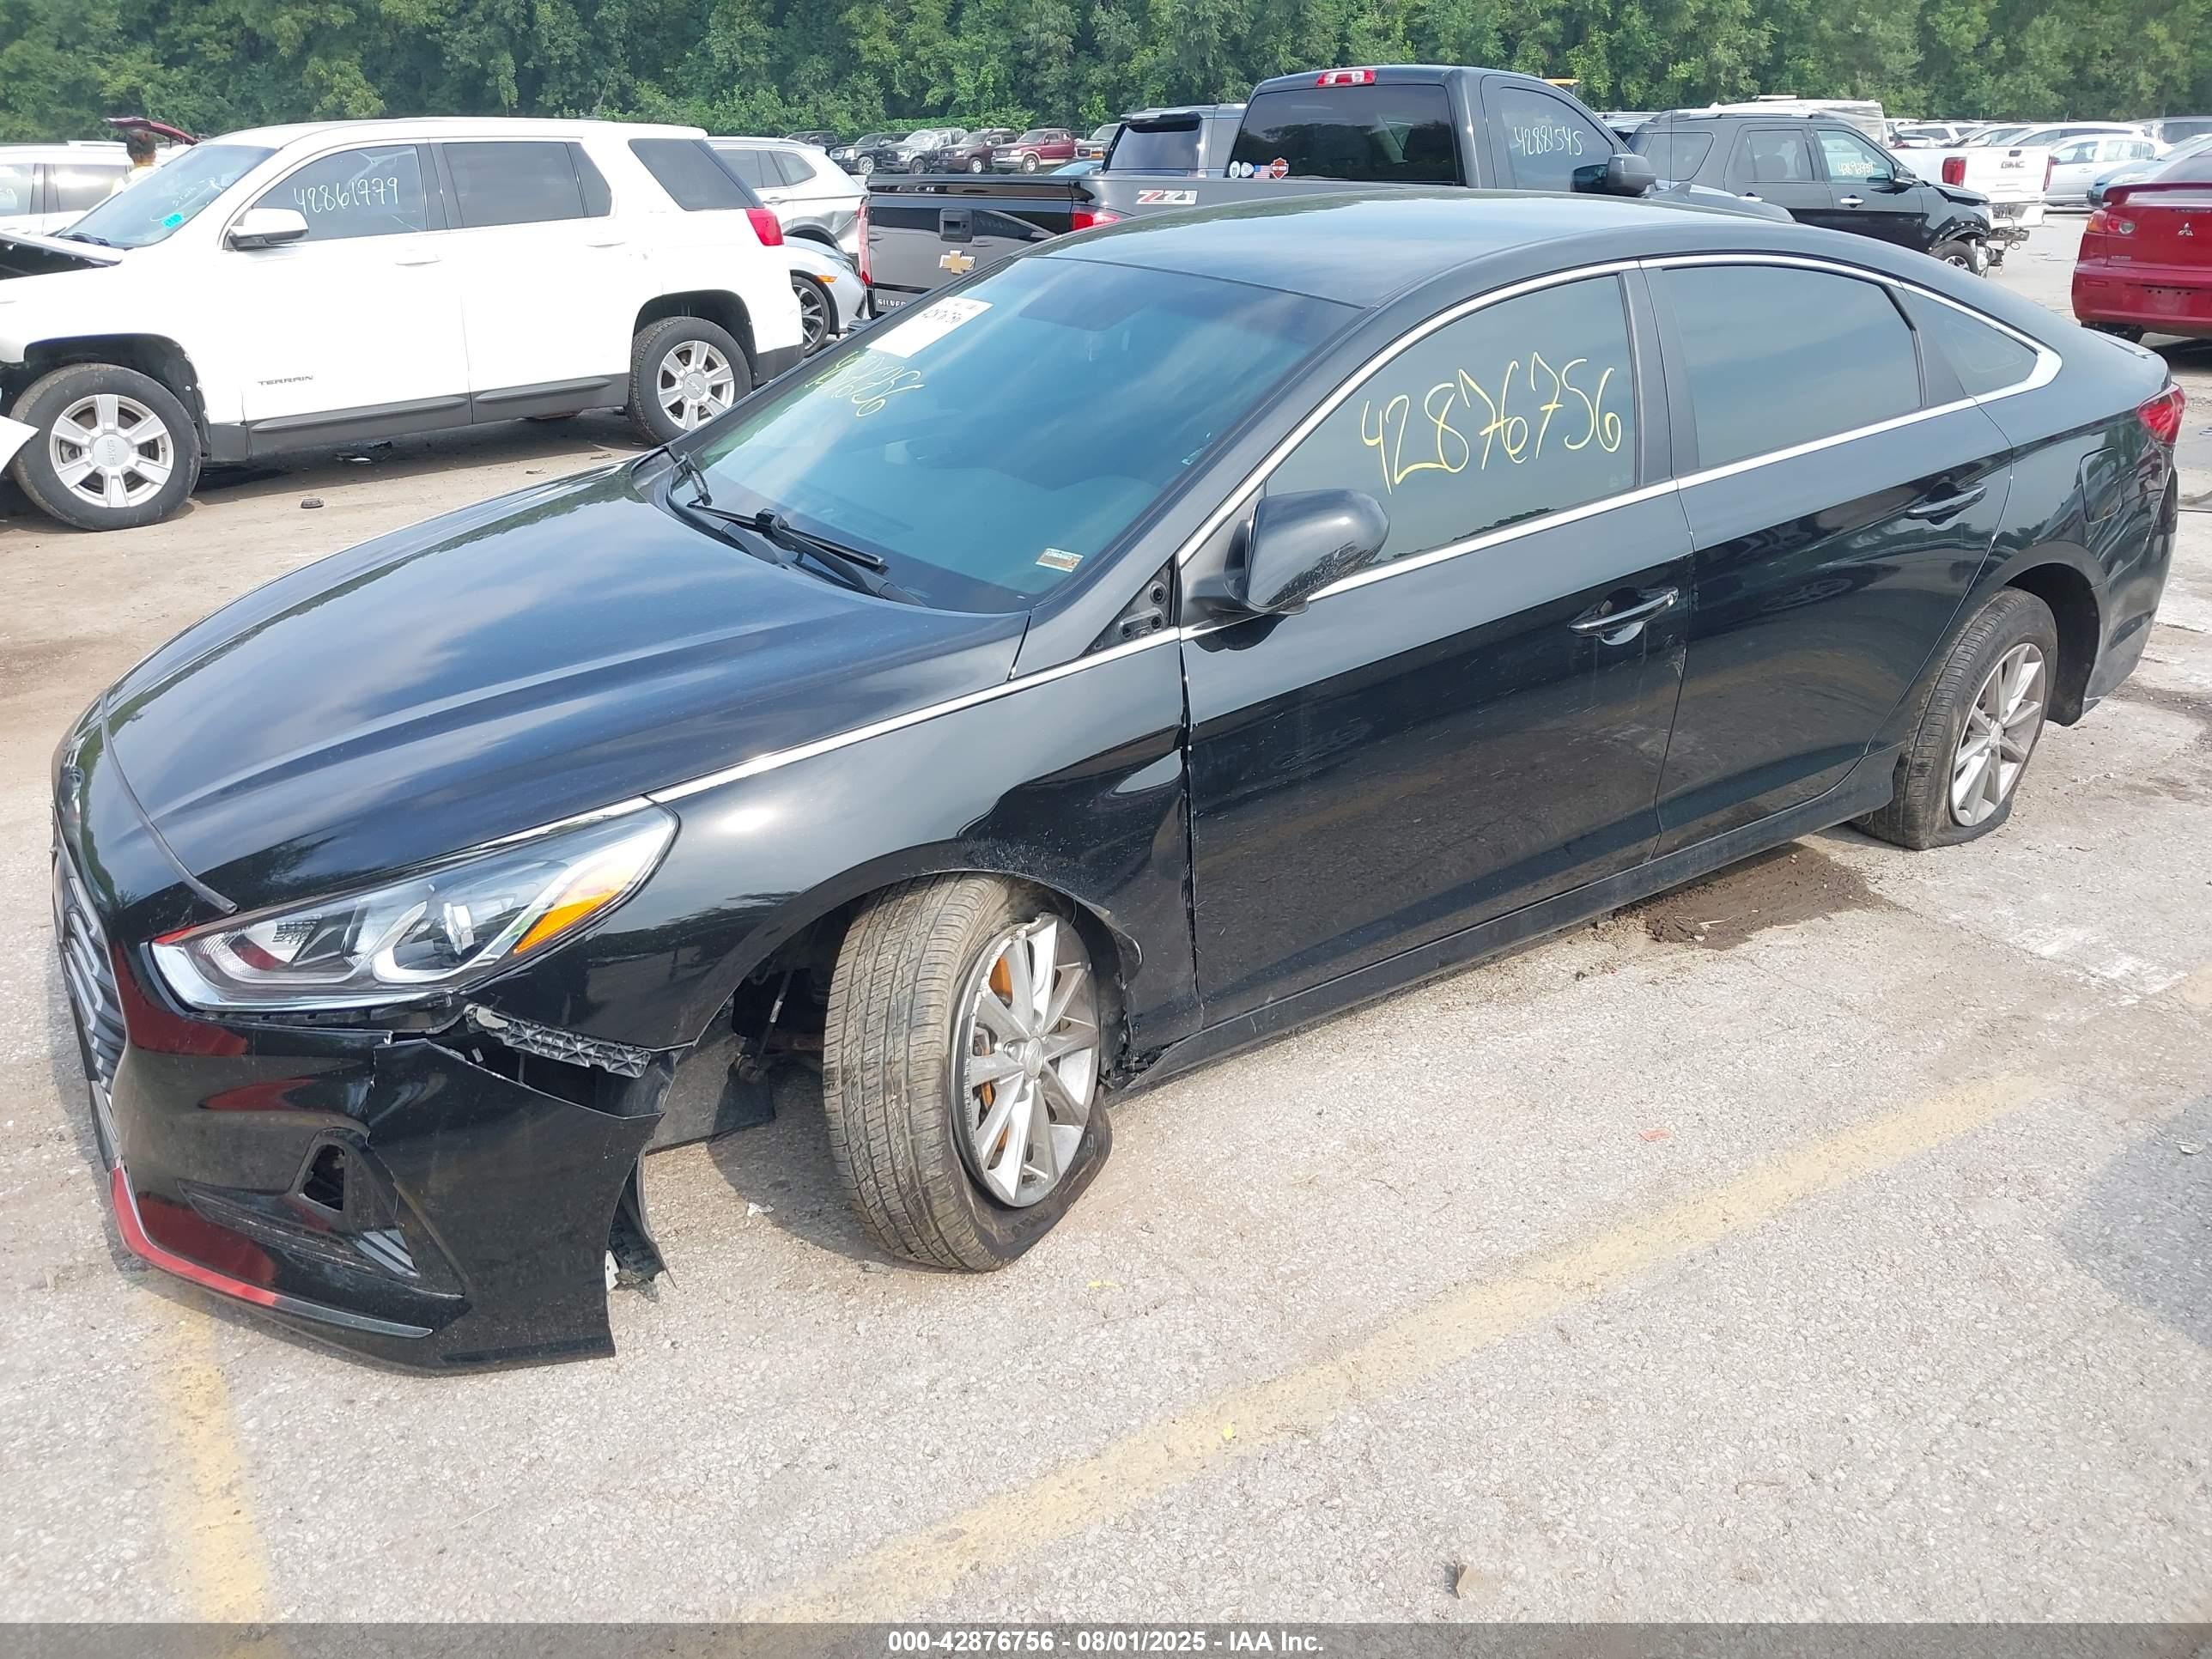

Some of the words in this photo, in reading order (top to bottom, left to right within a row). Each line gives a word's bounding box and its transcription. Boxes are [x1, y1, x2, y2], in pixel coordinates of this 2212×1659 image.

[1514, 125, 1585, 157] 42881545
[2001, 161, 2025, 169] GMC
[293, 177, 398, 216] 42861779
[1135, 190, 1199, 205] Z71
[257, 374, 313, 386] TERRAIN
[1360, 350, 1623, 495] 42876756
